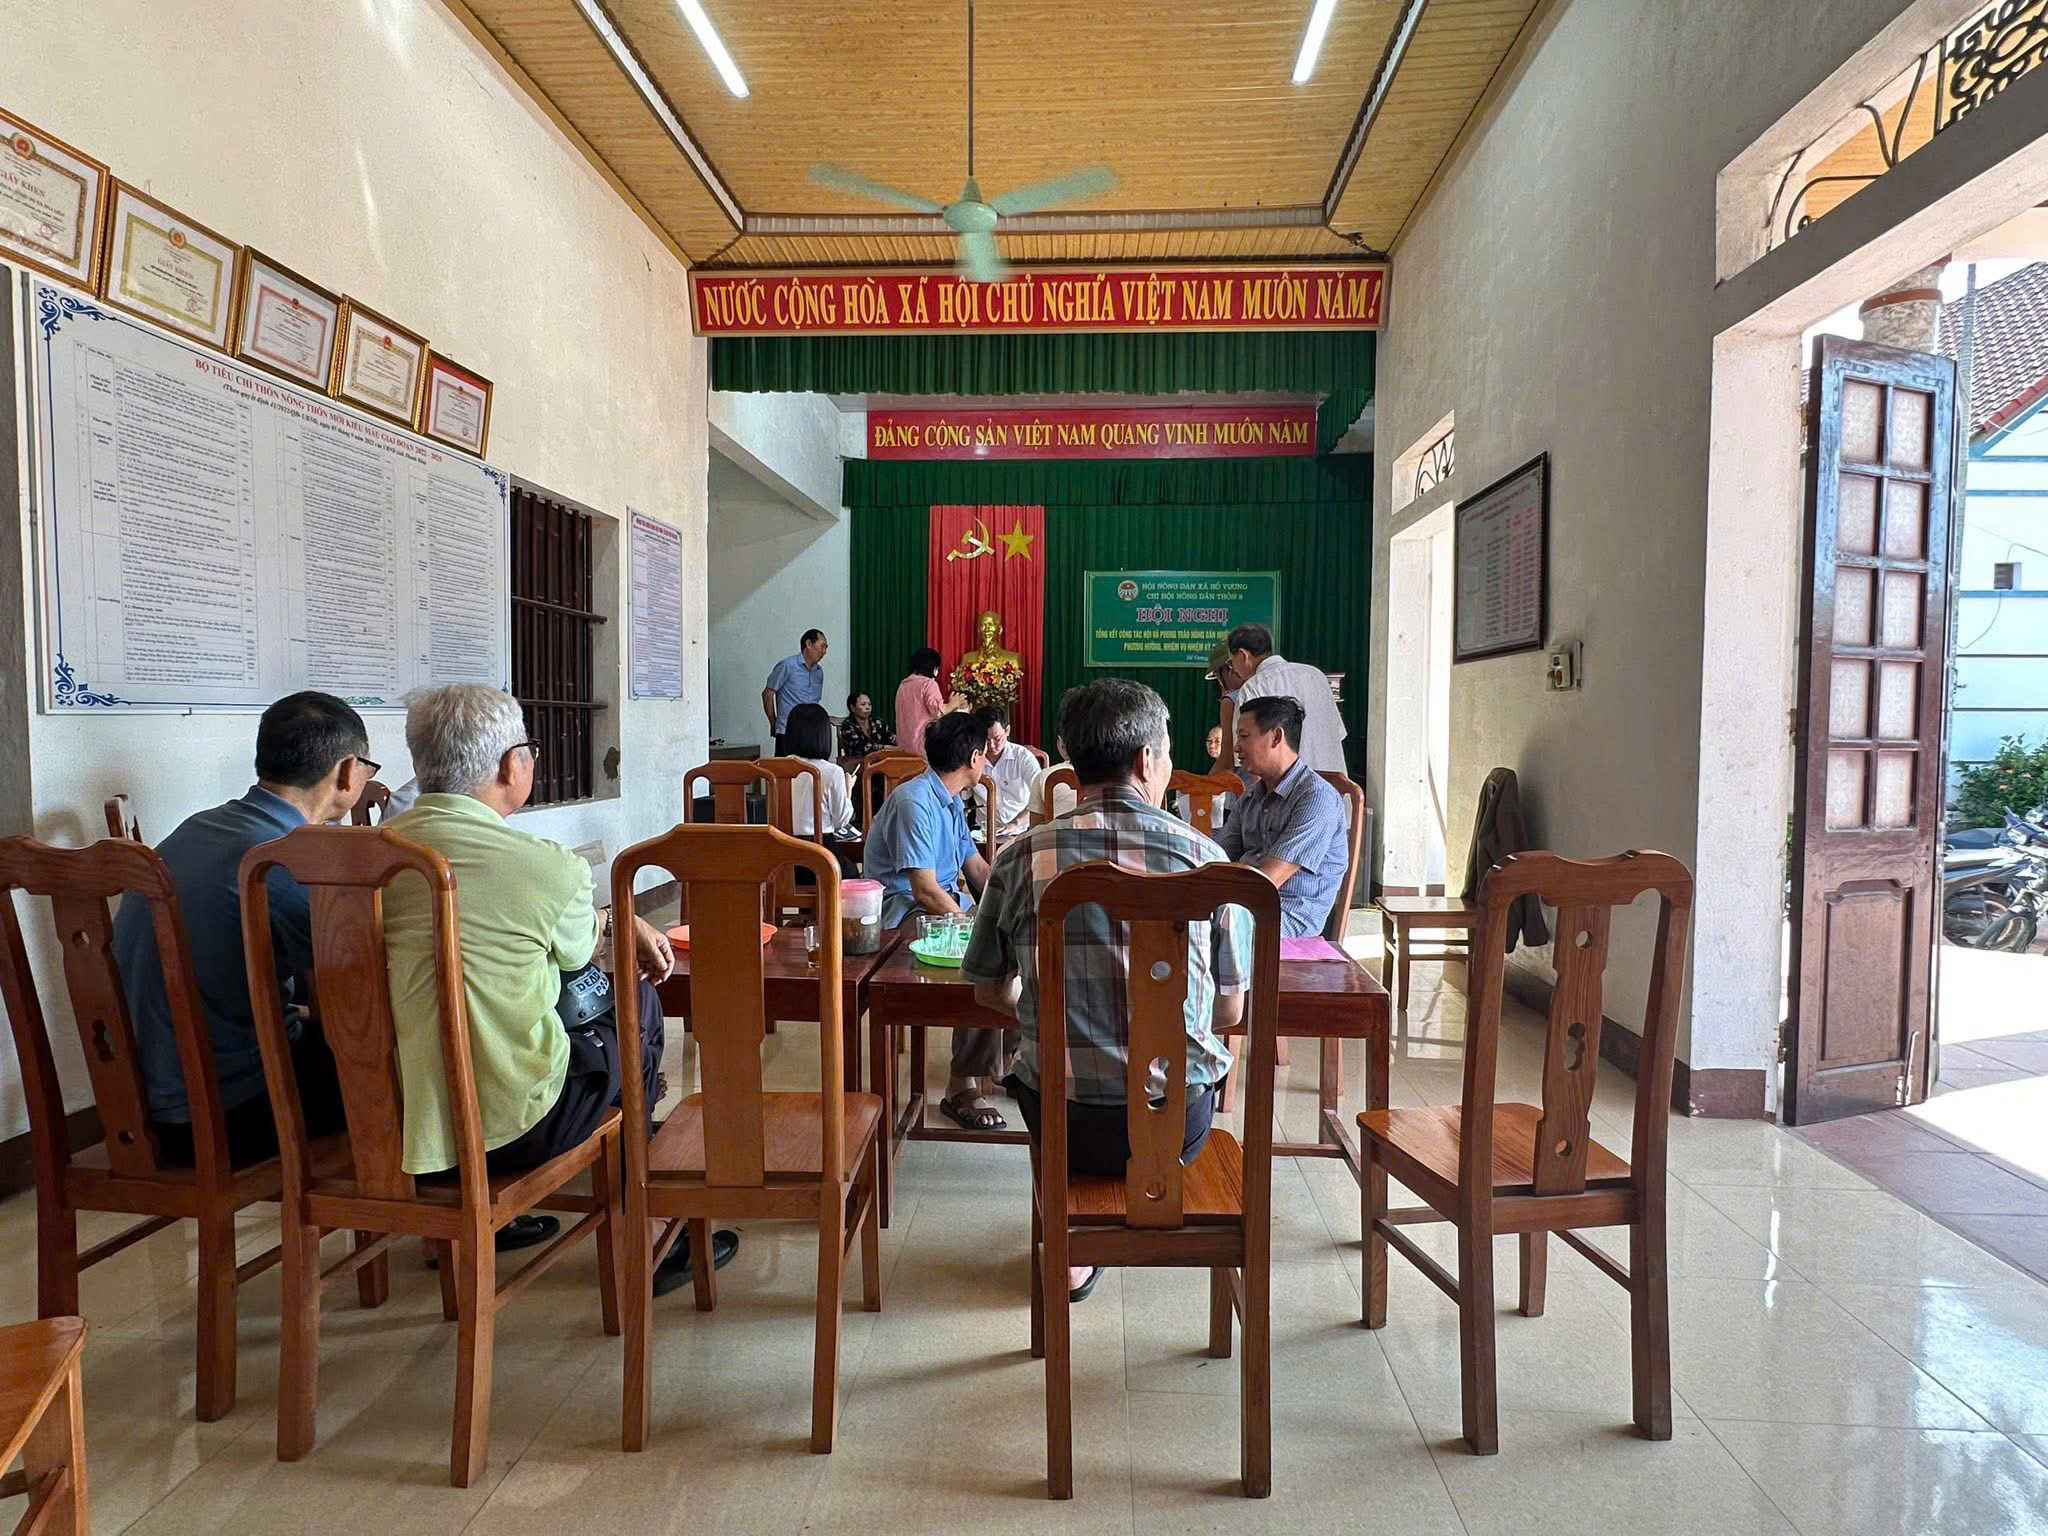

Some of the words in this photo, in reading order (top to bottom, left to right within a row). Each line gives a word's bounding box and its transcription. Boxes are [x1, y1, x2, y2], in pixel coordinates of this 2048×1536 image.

[703, 278, 767, 326] NƯỚC
[774, 277, 836, 329] CỘNG
[842, 276, 890, 324] HÒA
[898, 276, 930, 324] XÃ
[938, 275, 980, 327] HỘI
[986, 273, 1035, 323] CHỦ
[1042, 273, 1115, 322] NGHĨA
[1120, 273, 1176, 325] VIỆT
[1181, 279, 1234, 320] NAM
[1240, 272, 1309, 320] MUÔN
[1314, 272, 1382, 320] NĂM!
[195, 359, 209, 373] BỘ
[236, 375, 252, 388] CHÍ
[254, 383, 279, 399] THÔN
[281, 392, 305, 409] NÔNG
[306, 403, 328, 418] THÔN
[874, 418, 920, 447] ĐẢNG
[924, 419, 971, 450] CỘNG
[975, 417, 1008, 446] SẢN
[1012, 418, 1053, 450] VIỆT
[1057, 424, 1096, 446] NAM
[1100, 423, 1159, 449] QUANG
[1164, 423, 1209, 445] VINH
[1213, 417, 1264, 445] MUÔN
[1268, 418, 1309, 444] NĂM
[1135, 602, 1173, 626] HỘI
[1177, 607, 1229, 626] NGHỊ
